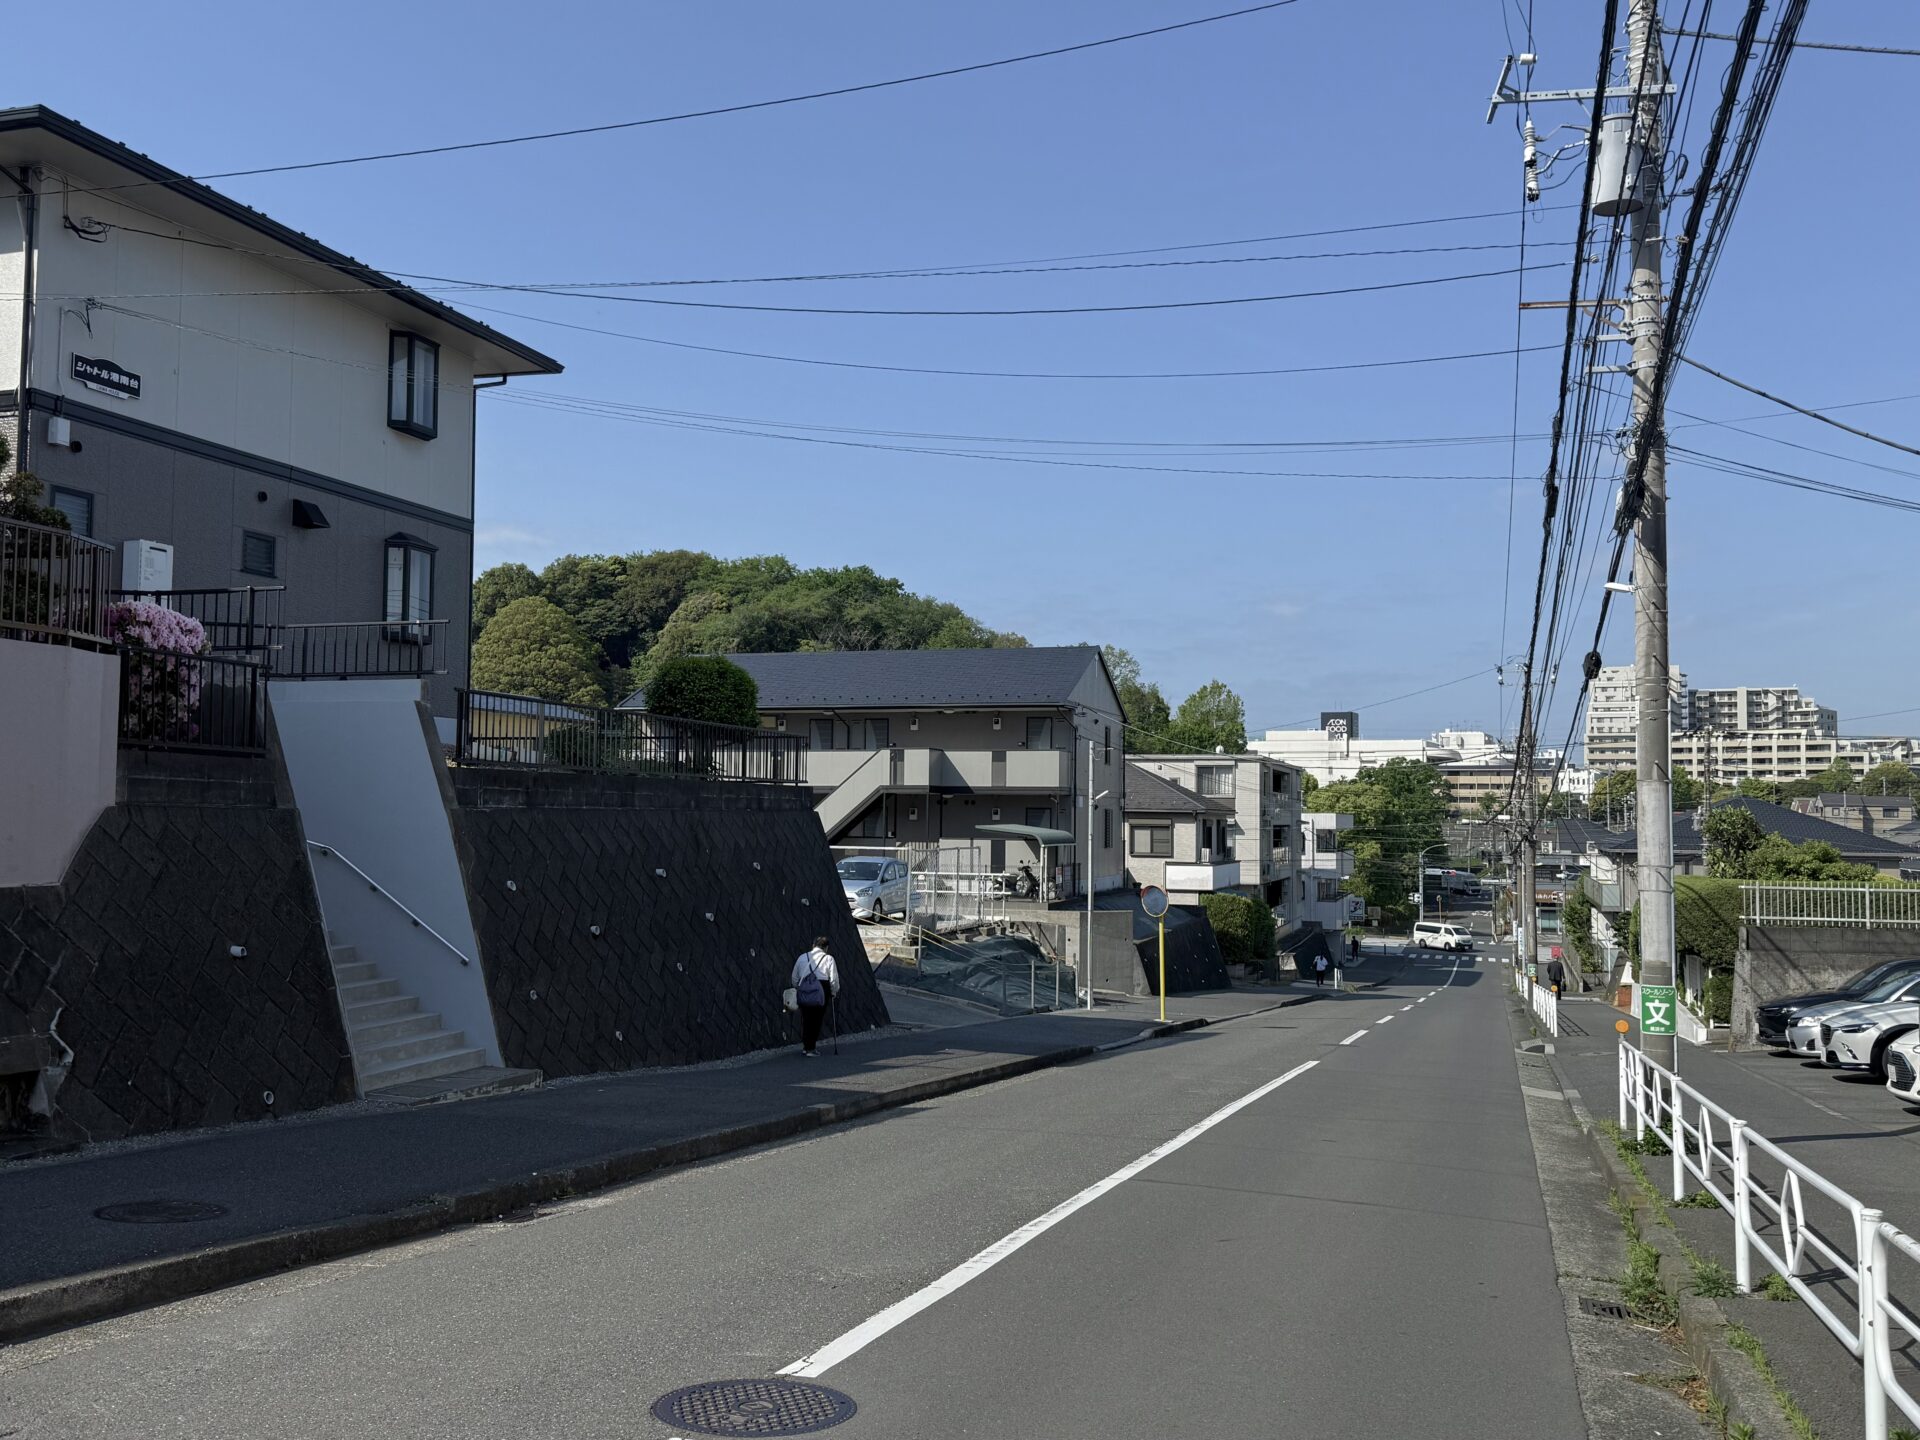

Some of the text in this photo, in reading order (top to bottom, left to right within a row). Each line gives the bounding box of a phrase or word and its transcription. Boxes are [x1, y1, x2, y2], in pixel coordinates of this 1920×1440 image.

[76, 361, 139, 389] シャトル港南台
[1645, 999, 1670, 1026] 文
